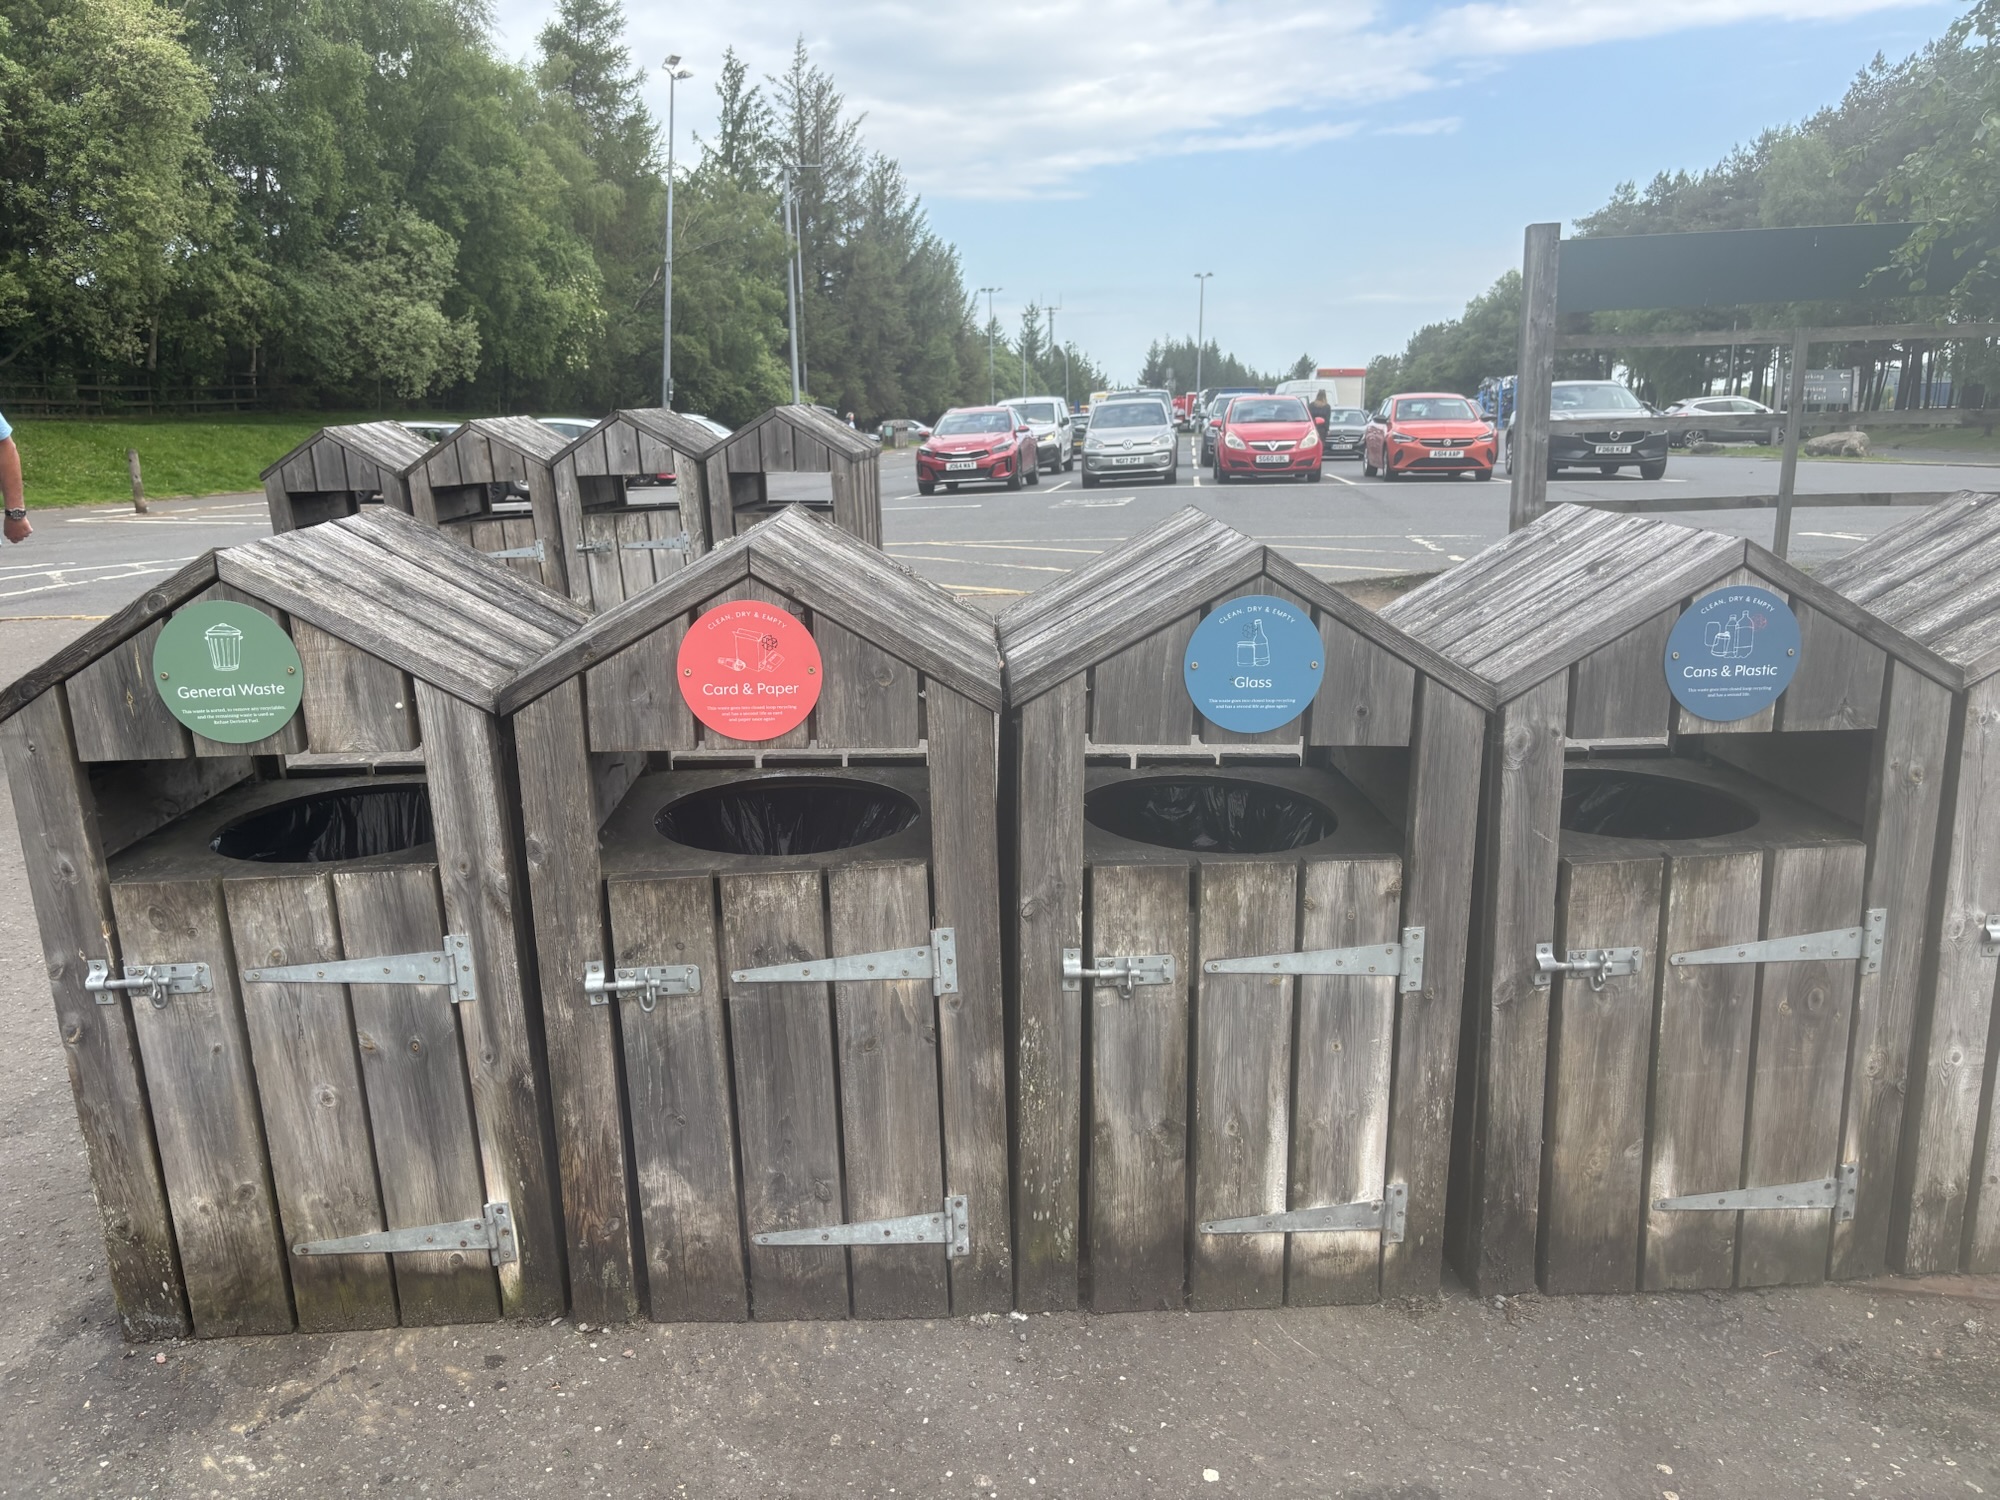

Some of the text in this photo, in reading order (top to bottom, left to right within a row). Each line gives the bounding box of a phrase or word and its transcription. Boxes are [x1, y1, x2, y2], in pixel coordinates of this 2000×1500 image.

[1700, 598, 1726, 614] CLEAN,
[1752, 598, 1776, 613] EMPTY
[707, 614, 734, 630] CLEAN,
[762, 614, 788, 629] EMPTY
[1218, 608, 1244, 624] CLEAN,
[1272, 608, 1296, 624] EMPTY
[1683, 664, 1778, 678] Cans & Plastic
[702, 682, 800, 698] Card & Paper
[1234, 676, 1272, 688] Glass
[177, 684, 286, 699] General Waste
